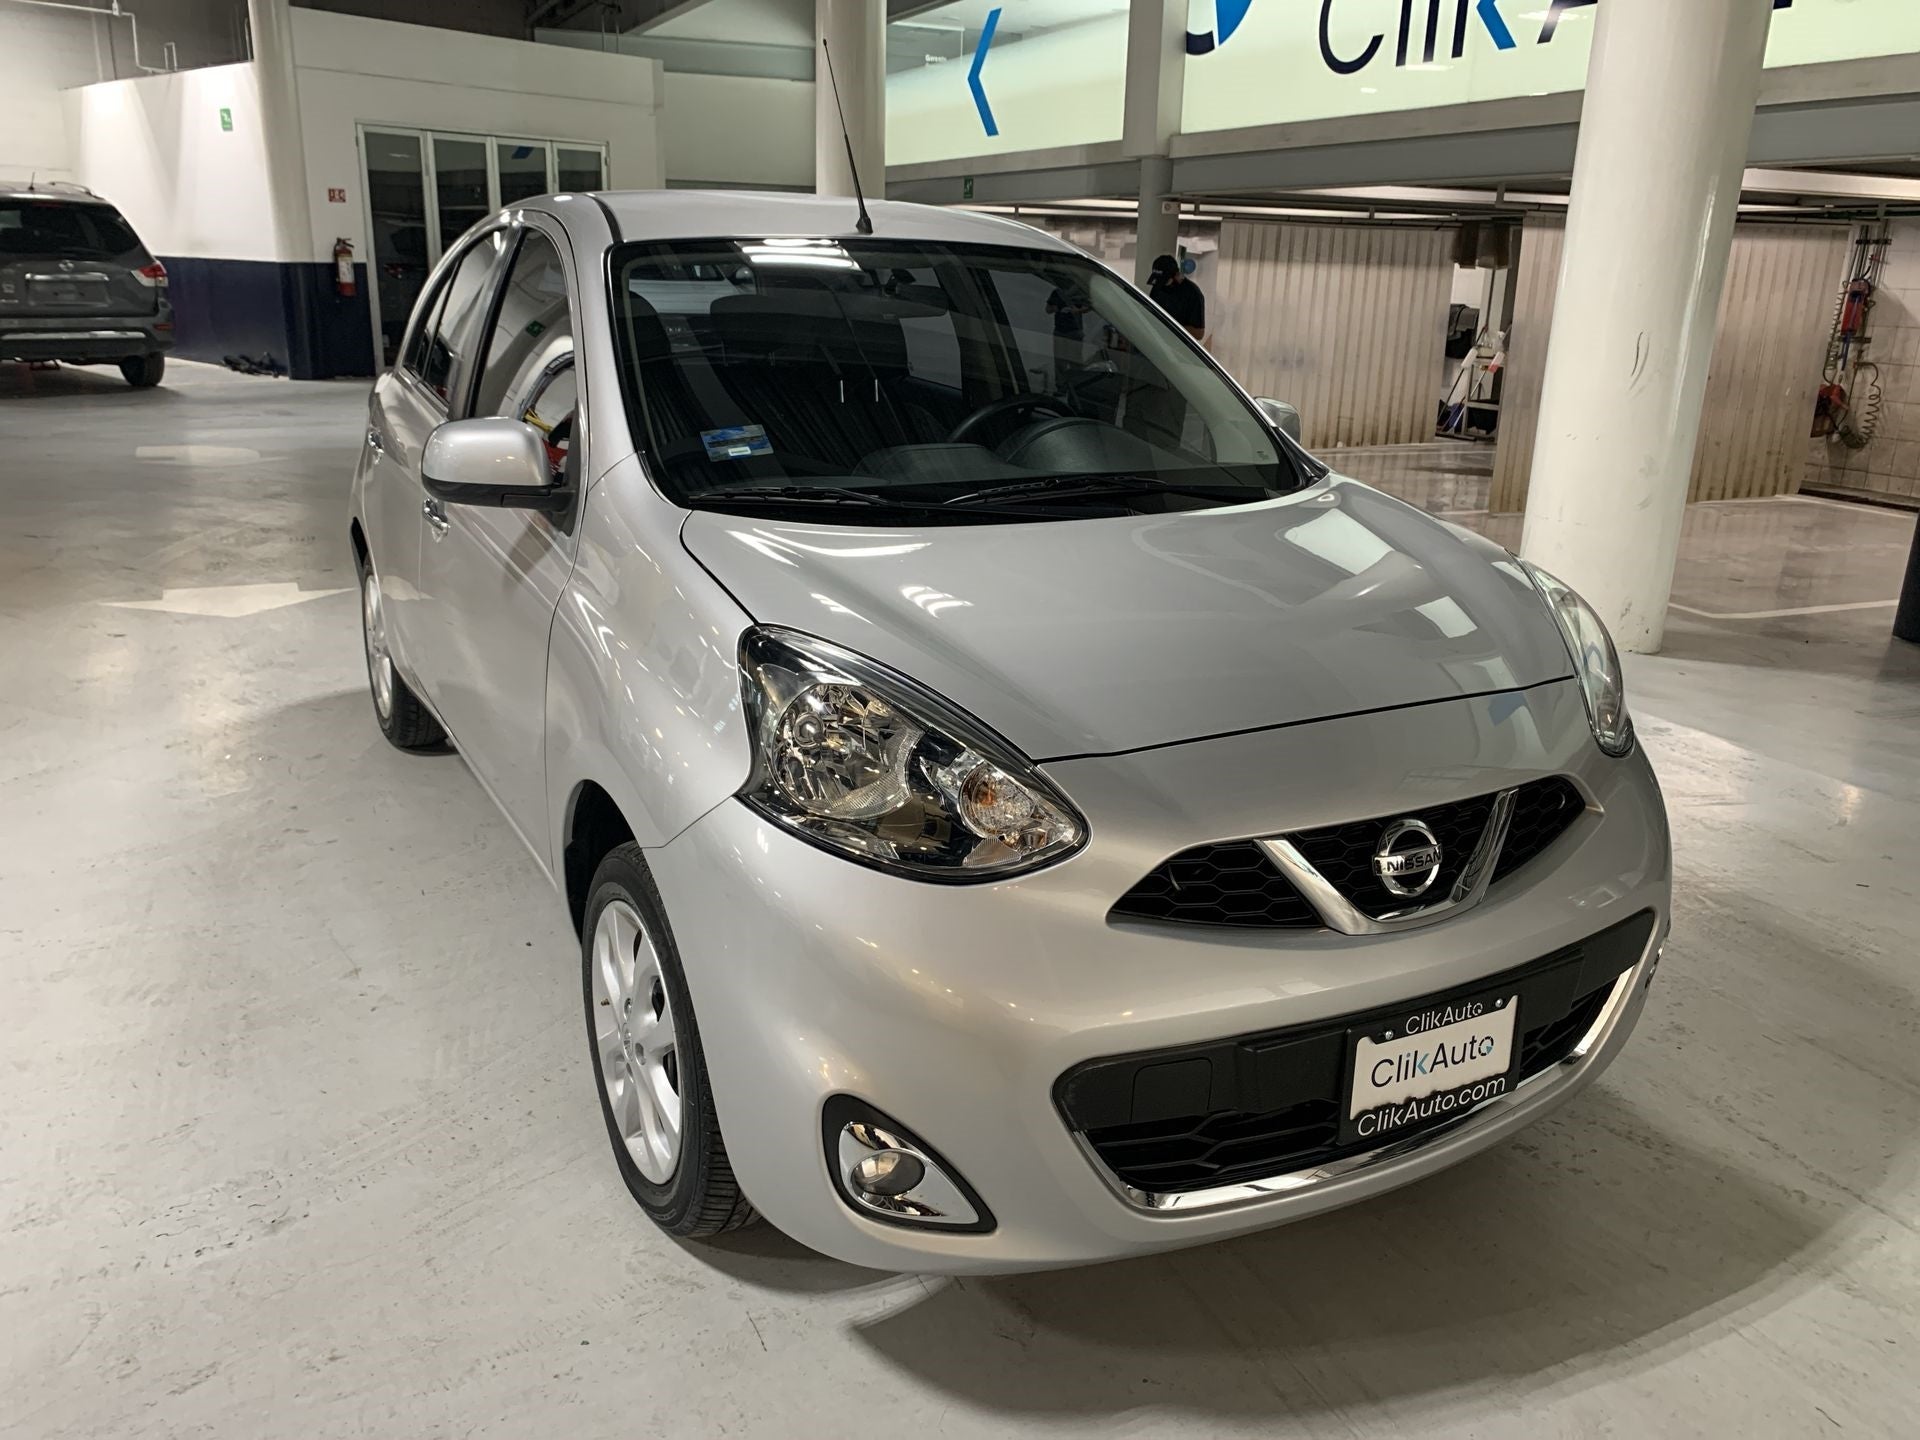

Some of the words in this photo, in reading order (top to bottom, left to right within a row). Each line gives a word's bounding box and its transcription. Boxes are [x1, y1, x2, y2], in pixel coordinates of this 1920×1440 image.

[1386, 847, 1441, 872] NISSAN
[1405, 1002, 1484, 1035] ClikAuto
[1371, 1035, 1495, 1088] ClikAuto
[1357, 1077, 1506, 1137] ClikAuto.com
